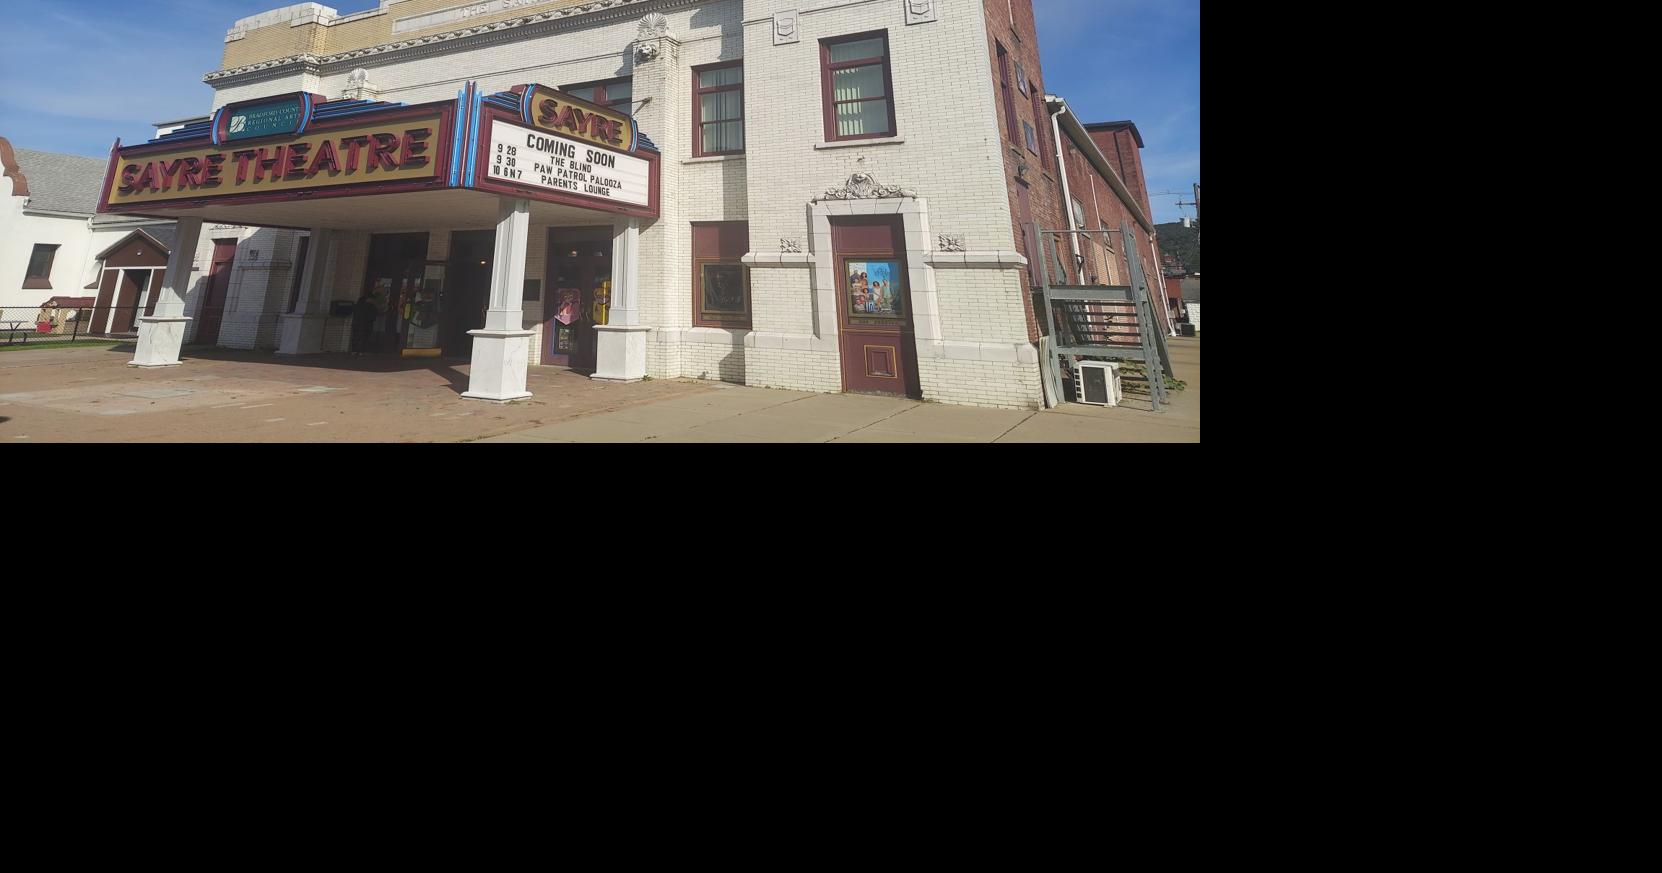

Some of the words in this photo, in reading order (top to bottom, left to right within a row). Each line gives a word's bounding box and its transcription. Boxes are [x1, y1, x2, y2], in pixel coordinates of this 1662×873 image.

[247, 116, 281, 126] REGIONAL
[538, 98, 623, 145] SAYRE
[117, 153, 226, 196] SAYRE
[231, 128, 433, 185] THEATRE
[497, 143, 503, 153] 9
[506, 145, 517, 156] 28
[550, 156, 566, 167] THE
[569, 160, 592, 173] BLIND
[527, 133, 576, 159] COMING
[586, 149, 615, 169] SOON
[493, 165, 500, 175] 10
[541, 175, 578, 190] PARENTS
[584, 184, 610, 196] LOUNGE
[496, 154, 502, 164] 9
[506, 156, 516, 167] 30
[534, 162, 553, 175] PAW
[557, 167, 588, 182] PATROL
[590, 174, 622, 189] PALOOZA
